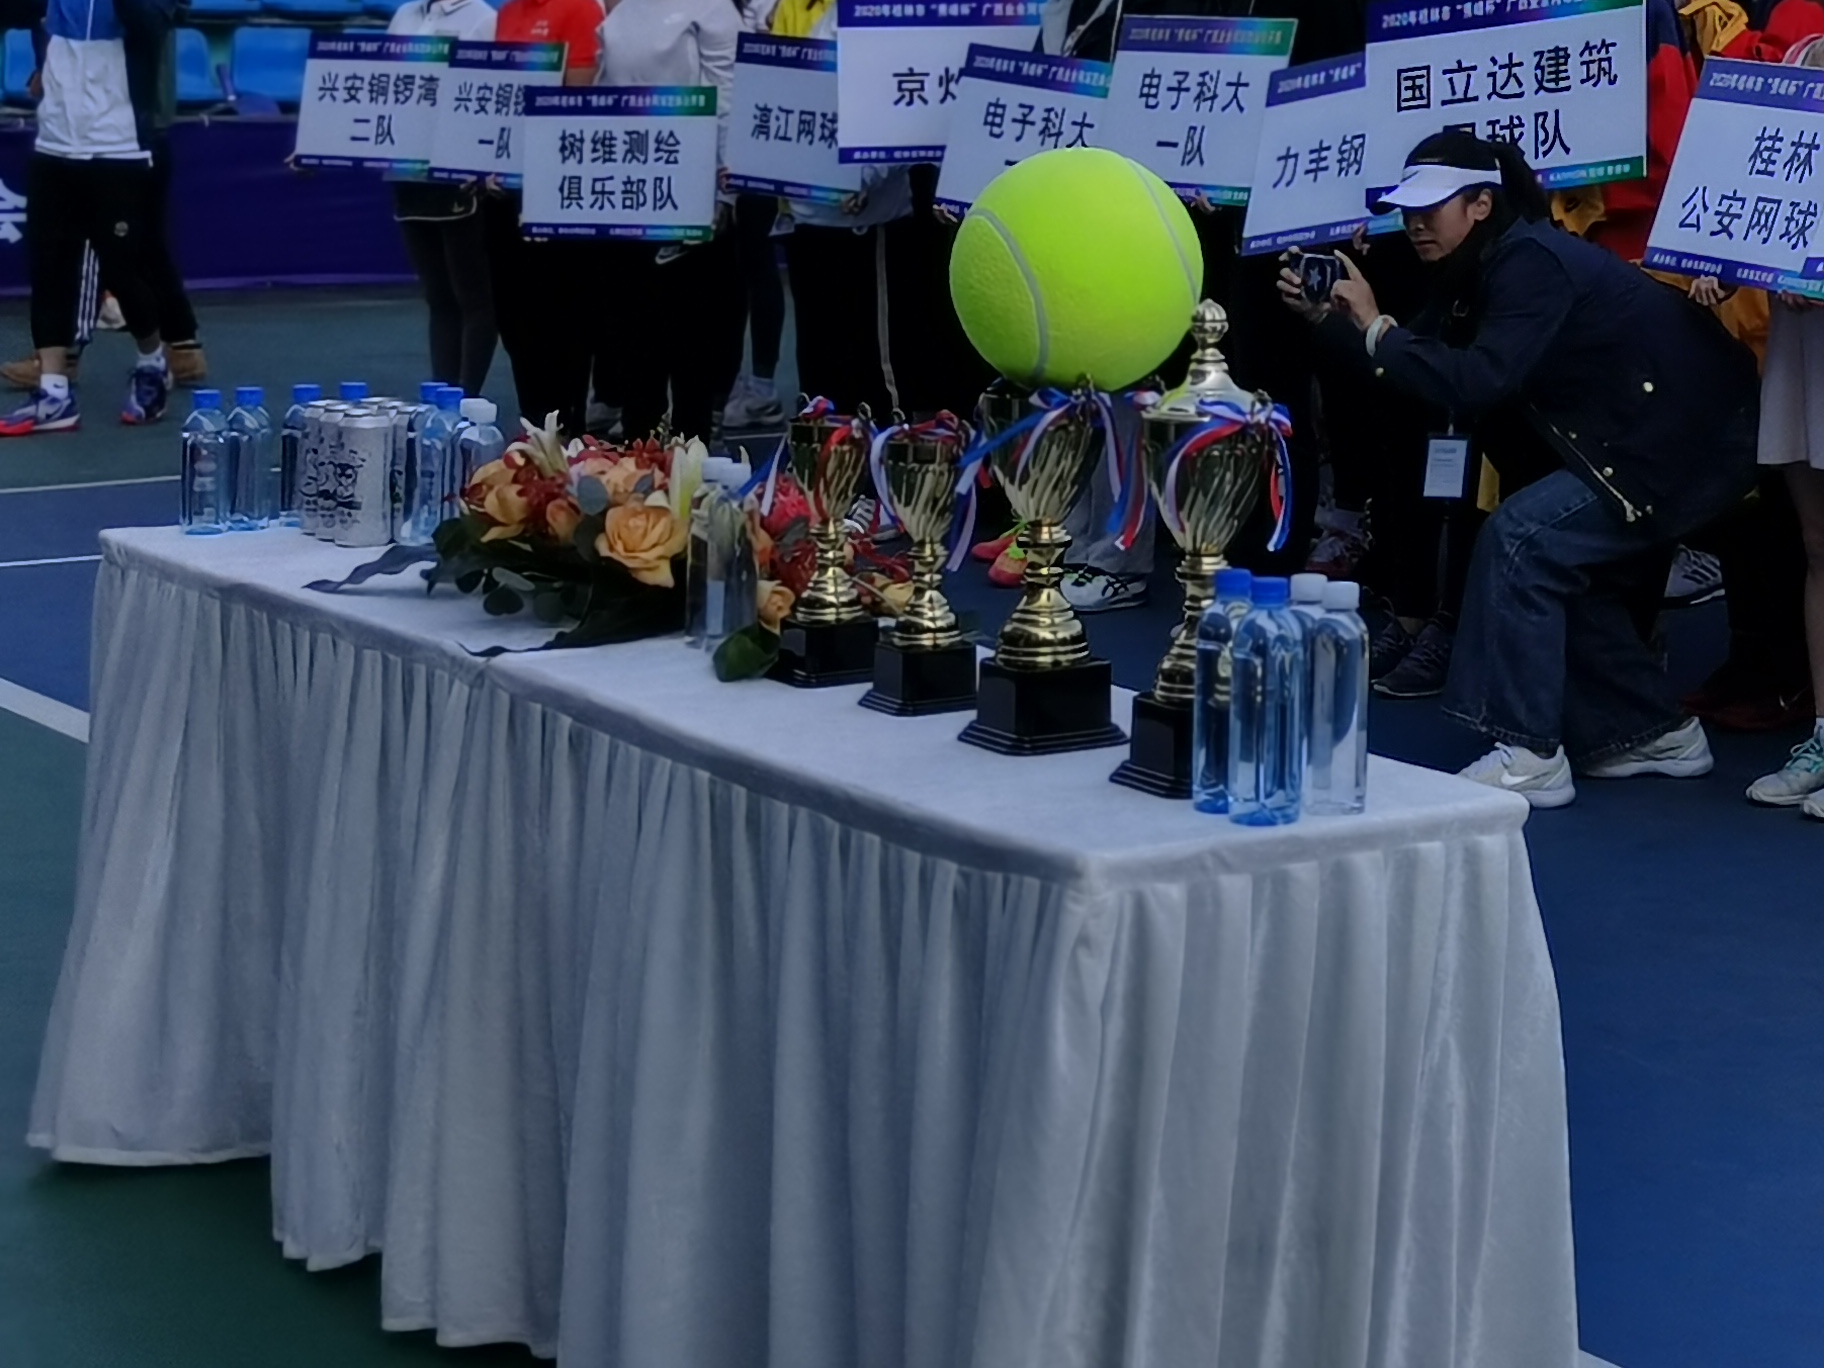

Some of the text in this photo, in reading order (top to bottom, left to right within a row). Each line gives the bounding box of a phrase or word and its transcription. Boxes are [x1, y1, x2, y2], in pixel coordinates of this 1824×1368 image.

[1138, 68, 1250, 115] 电子科大
[1397, 39, 1618, 112] 国立达建筑
[350, 114, 395, 146] 二队
[478, 126, 511, 159] 一队
[983, 97, 1095, 149] 电子科大
[559, 129, 681, 166] 树维测绘
[1156, 126, 1205, 167] 一队
[1748, 126, 1821, 183] 桂林
[558, 175, 679, 212] 俱乐部队
[1678, 185, 1818, 250] 公安网球
